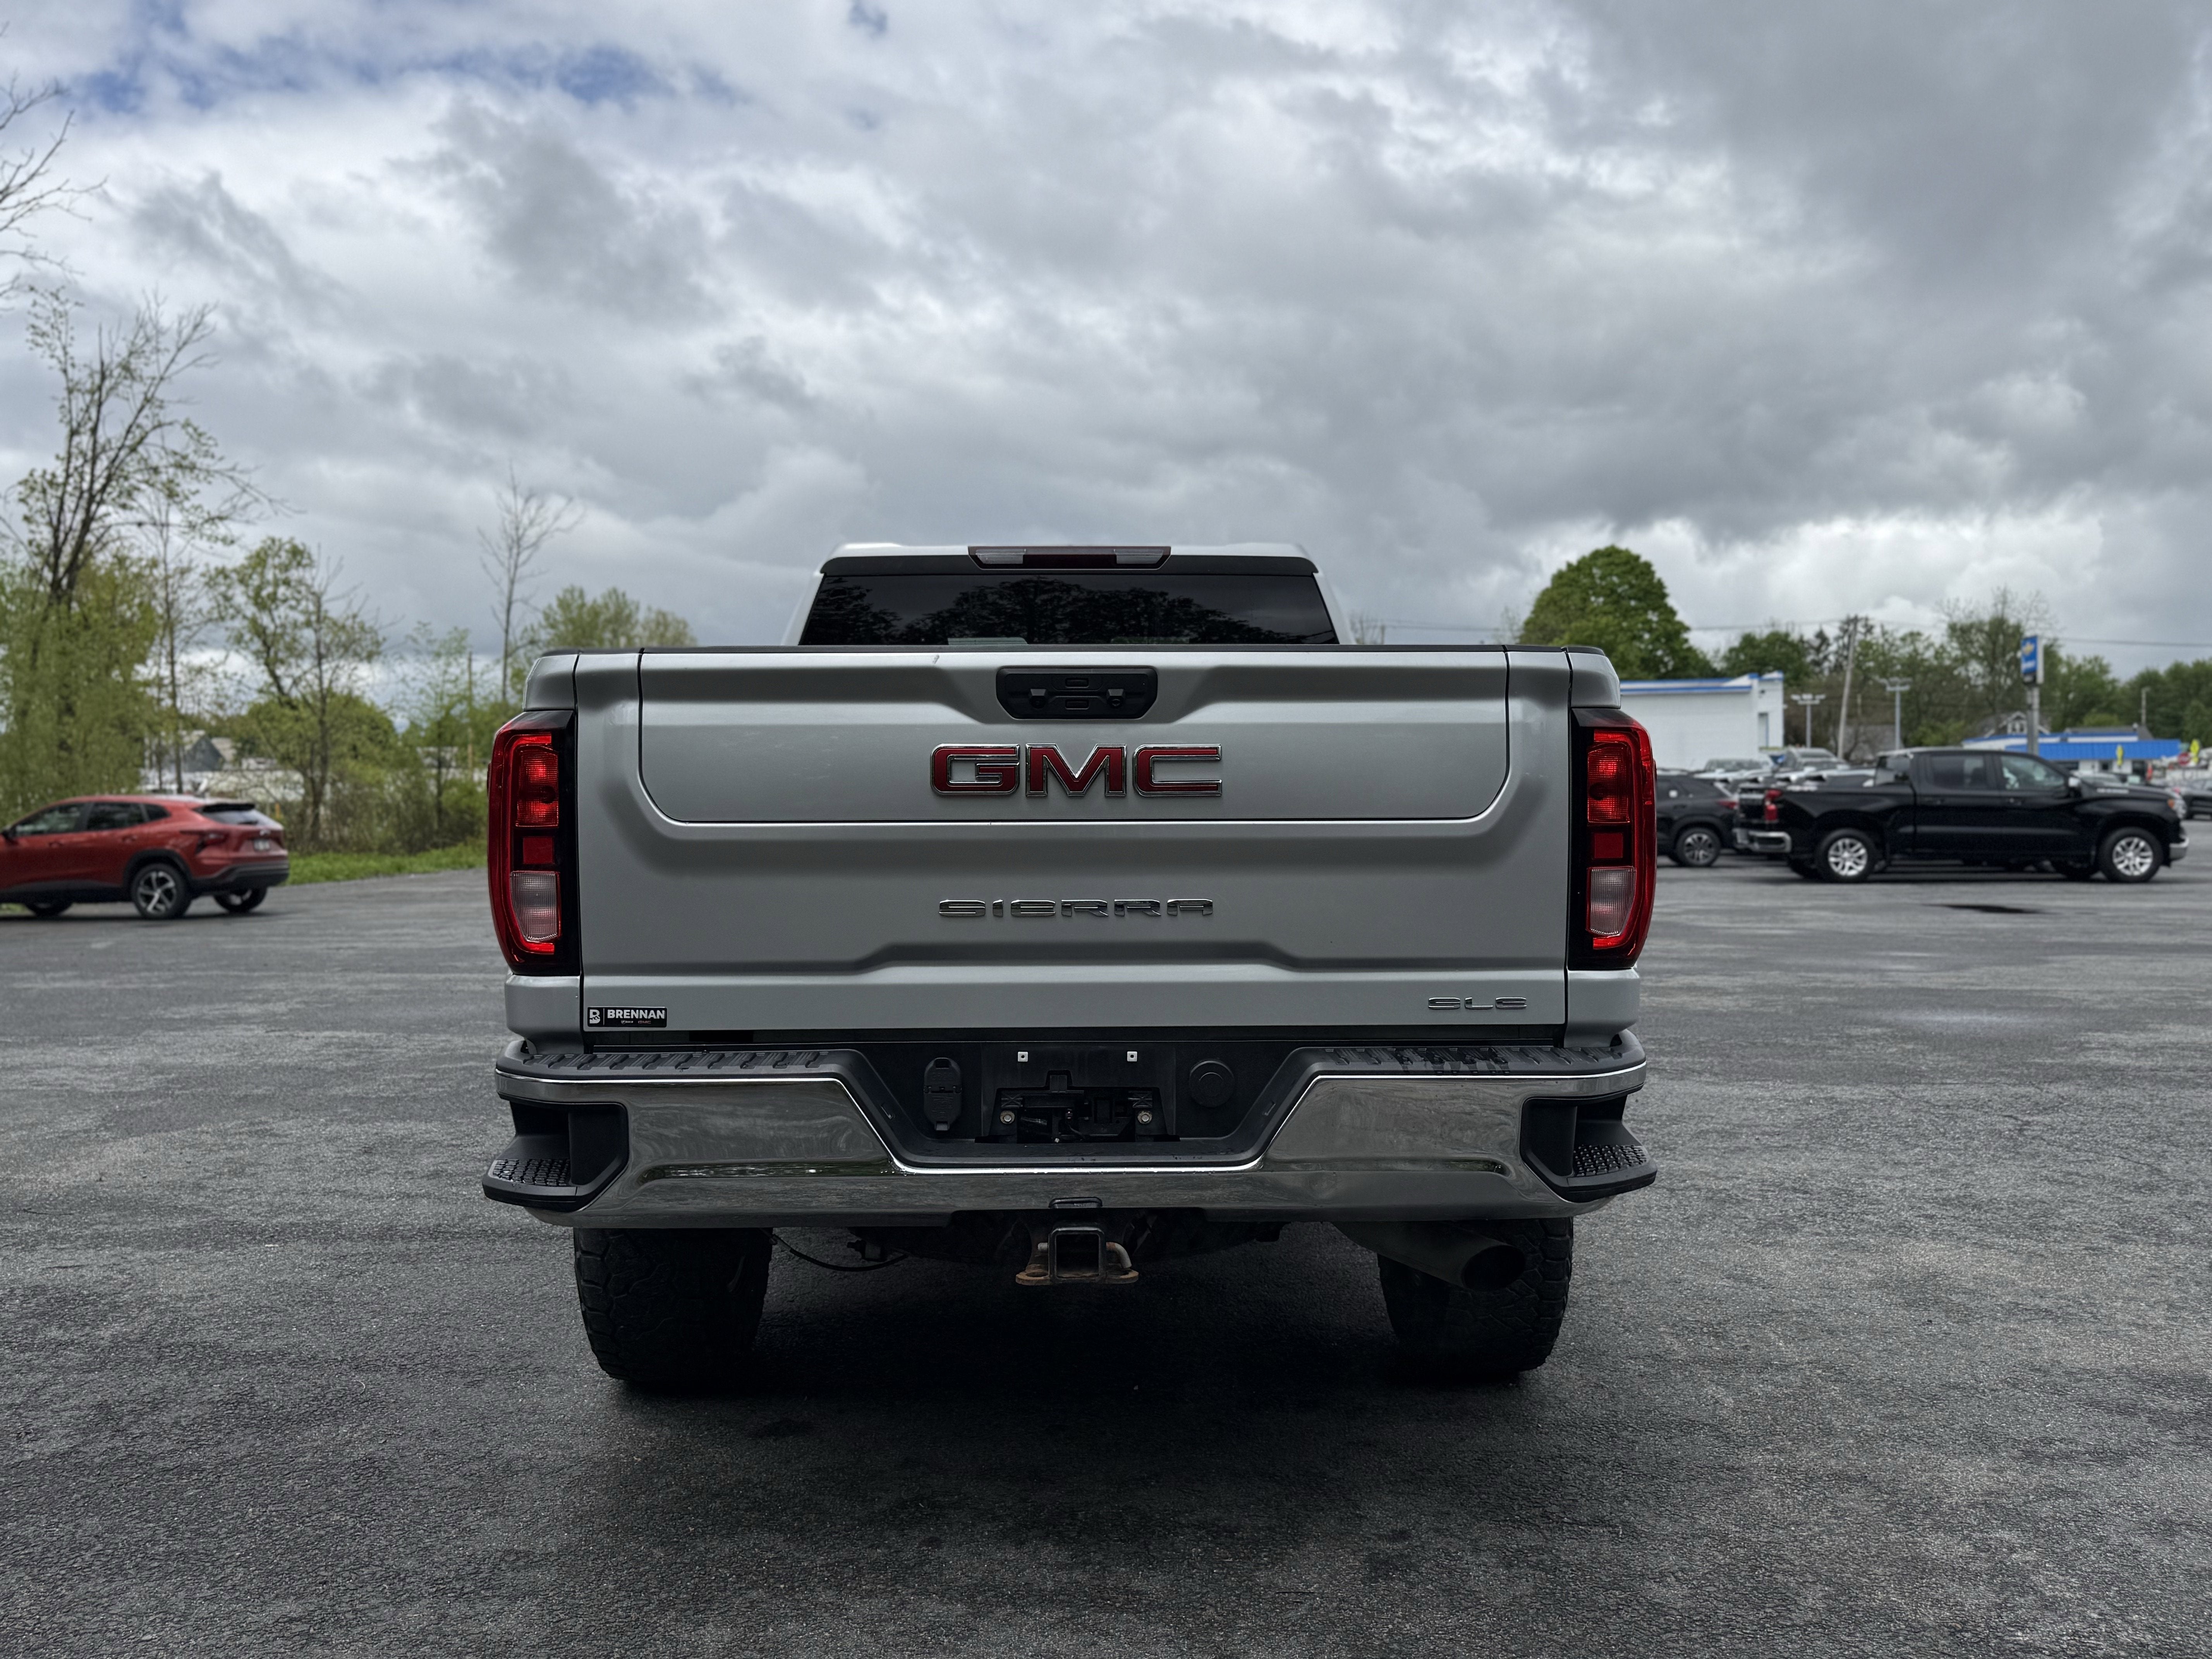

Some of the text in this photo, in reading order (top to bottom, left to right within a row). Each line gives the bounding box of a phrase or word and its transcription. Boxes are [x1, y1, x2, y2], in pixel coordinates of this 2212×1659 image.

[931, 743, 1222, 797] GMC
[939, 899, 1213, 917] SIERRA
[607, 1010, 665, 1019] BRENNAN
